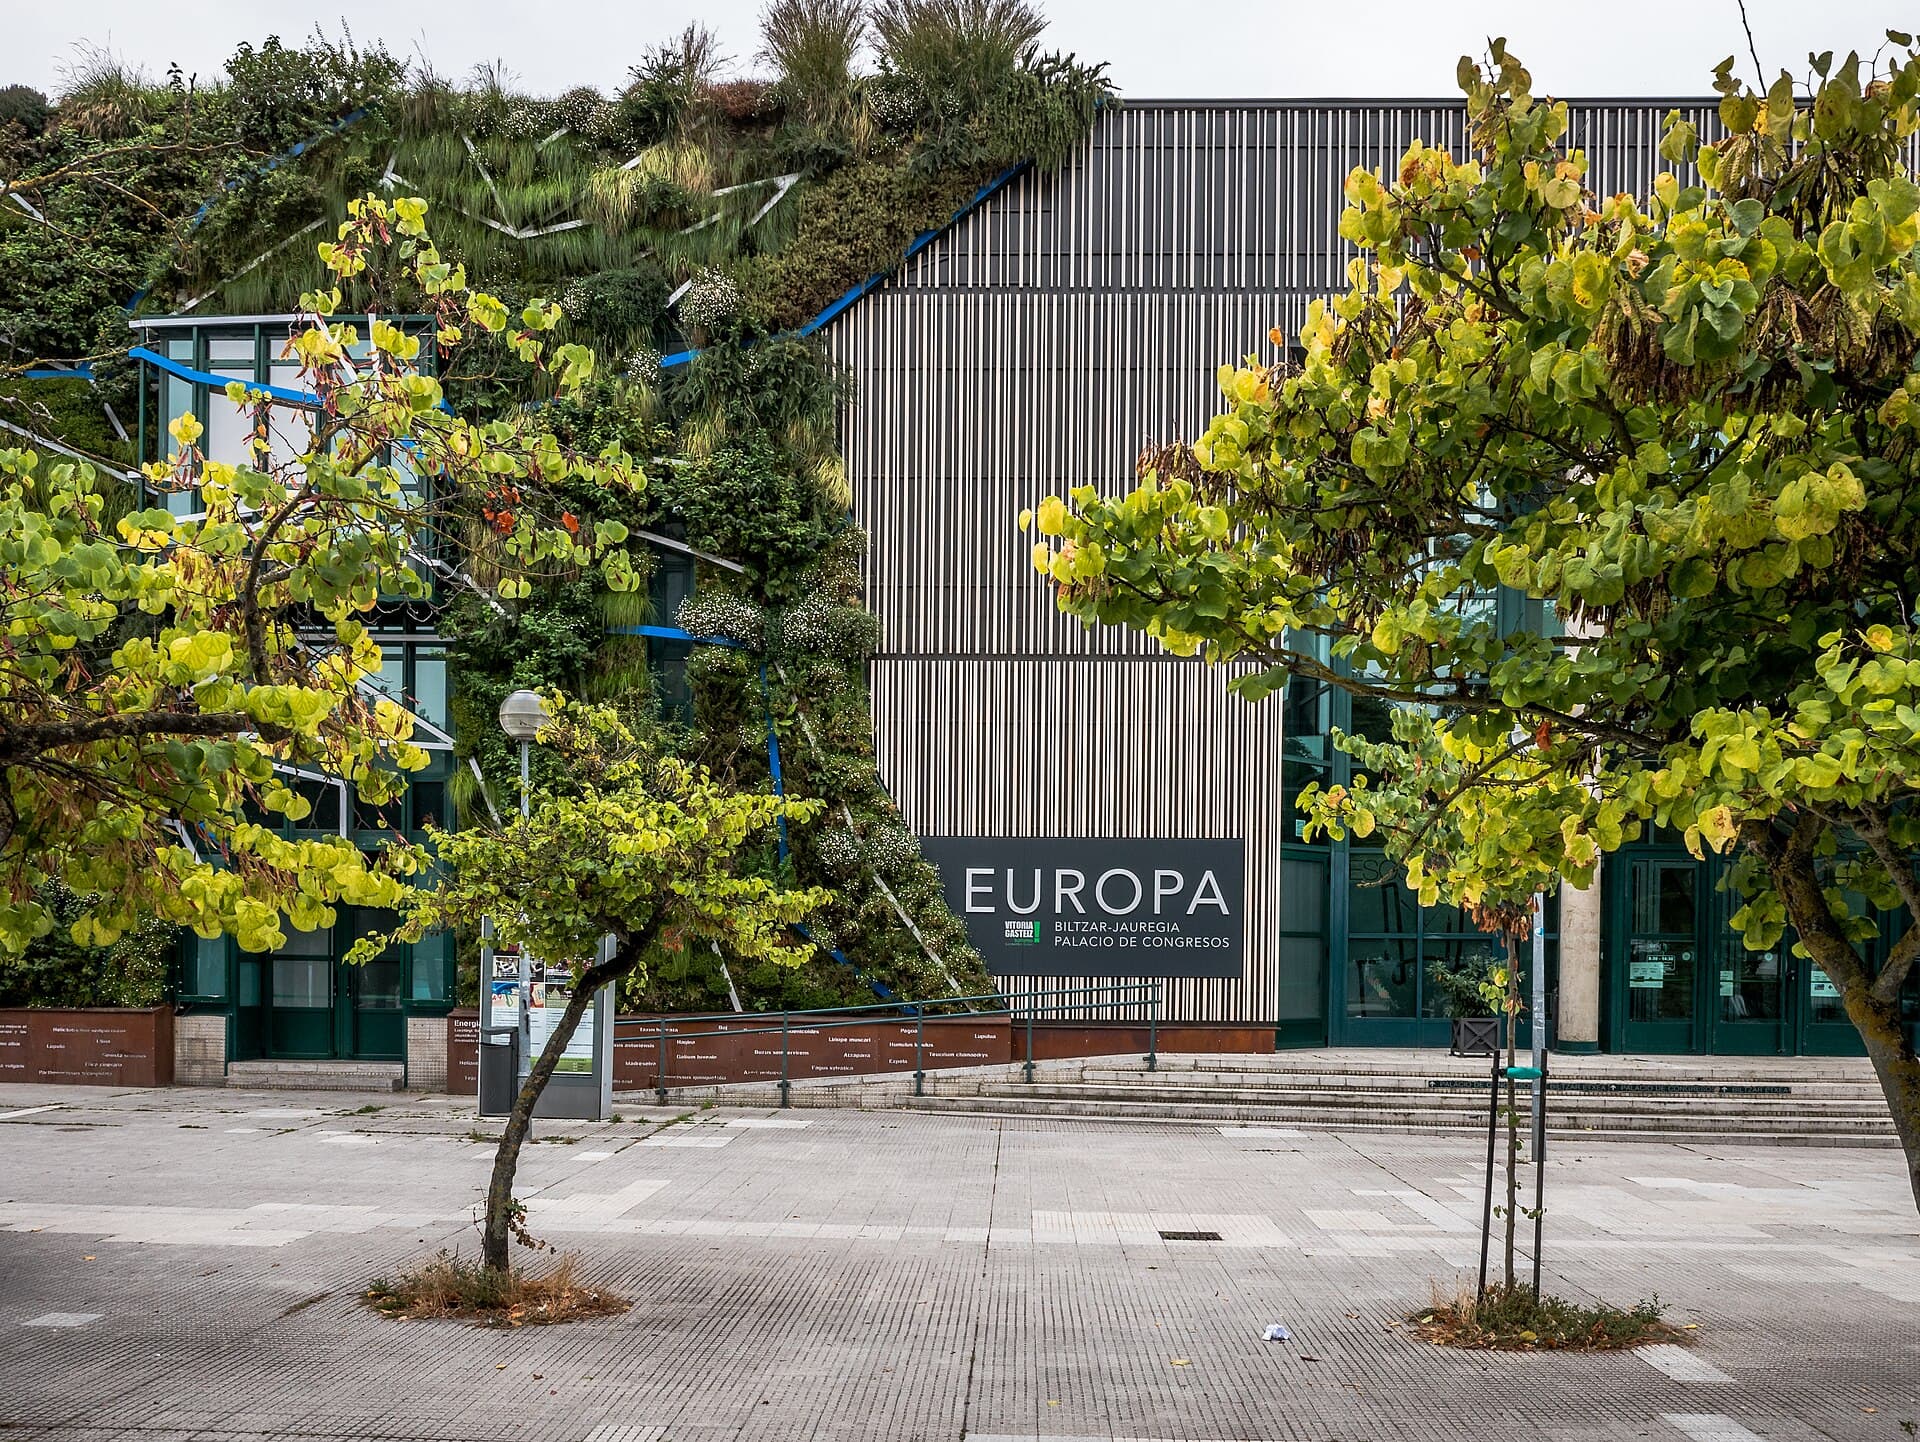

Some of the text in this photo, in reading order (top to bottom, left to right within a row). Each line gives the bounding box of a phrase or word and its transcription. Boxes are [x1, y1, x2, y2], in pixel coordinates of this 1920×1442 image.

[965, 867, 1230, 915] EUROPA
[1004, 920, 1034, 930] VITORIA
[1055, 921, 1180, 933] BILTZAR-JAUREGIA
[1004, 929, 1034, 938] GASTEIZ
[1055, 936, 1230, 949] PALACIO DE CONGRESOS
[454, 1019, 479, 1028] Energi
